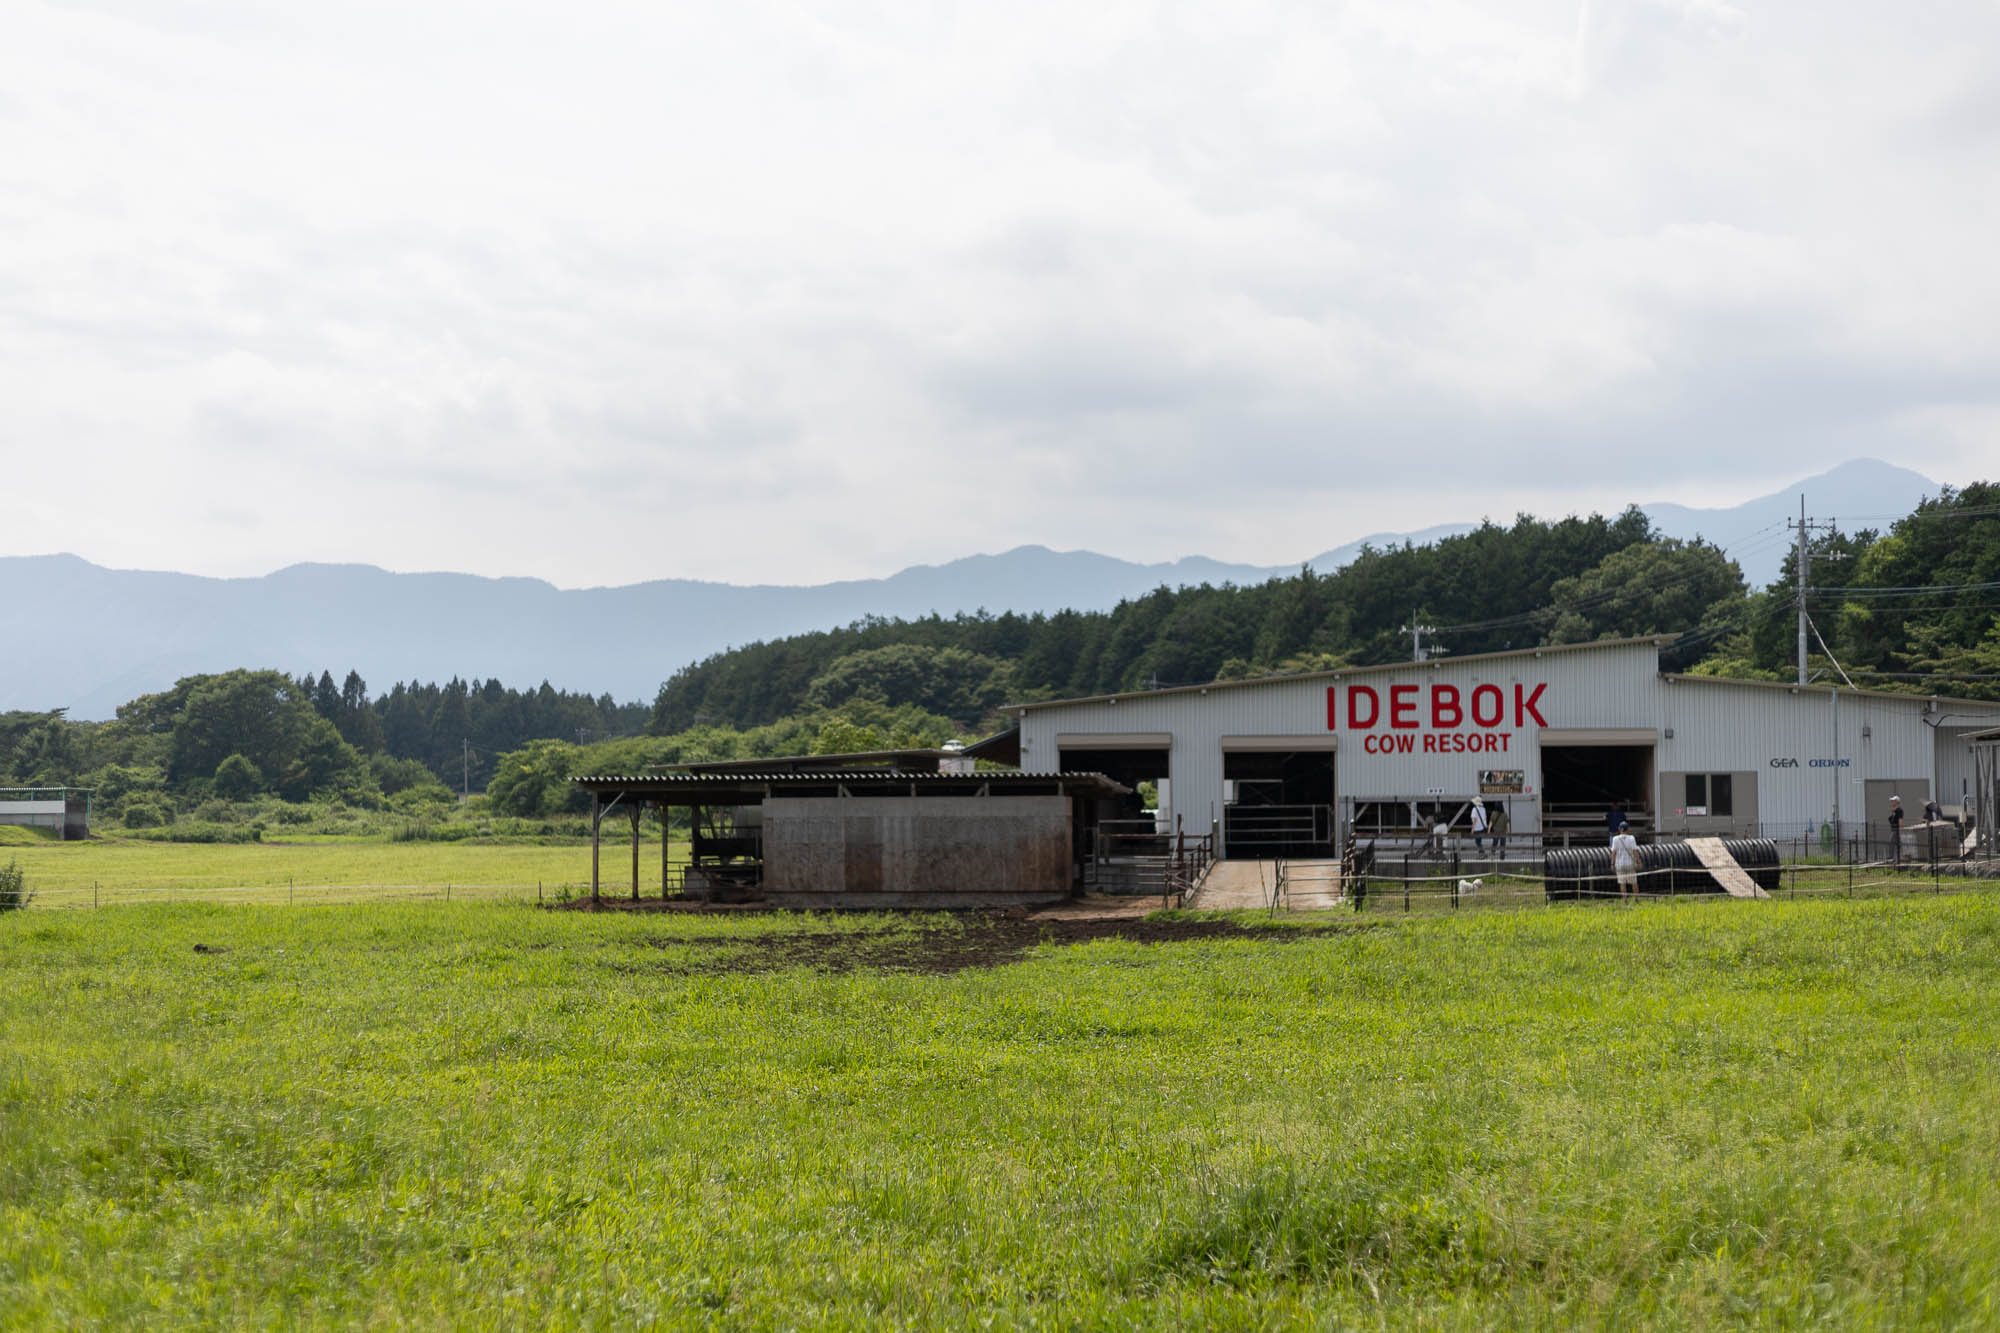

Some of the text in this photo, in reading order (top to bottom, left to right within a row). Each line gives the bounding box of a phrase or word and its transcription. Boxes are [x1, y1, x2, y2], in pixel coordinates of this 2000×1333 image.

[1327, 683, 1548, 731] IDEBOK
[1364, 732, 1512, 754] COW RESORT
[1769, 758, 1799, 768] GEA
[1808, 759, 1850, 768] ORION
